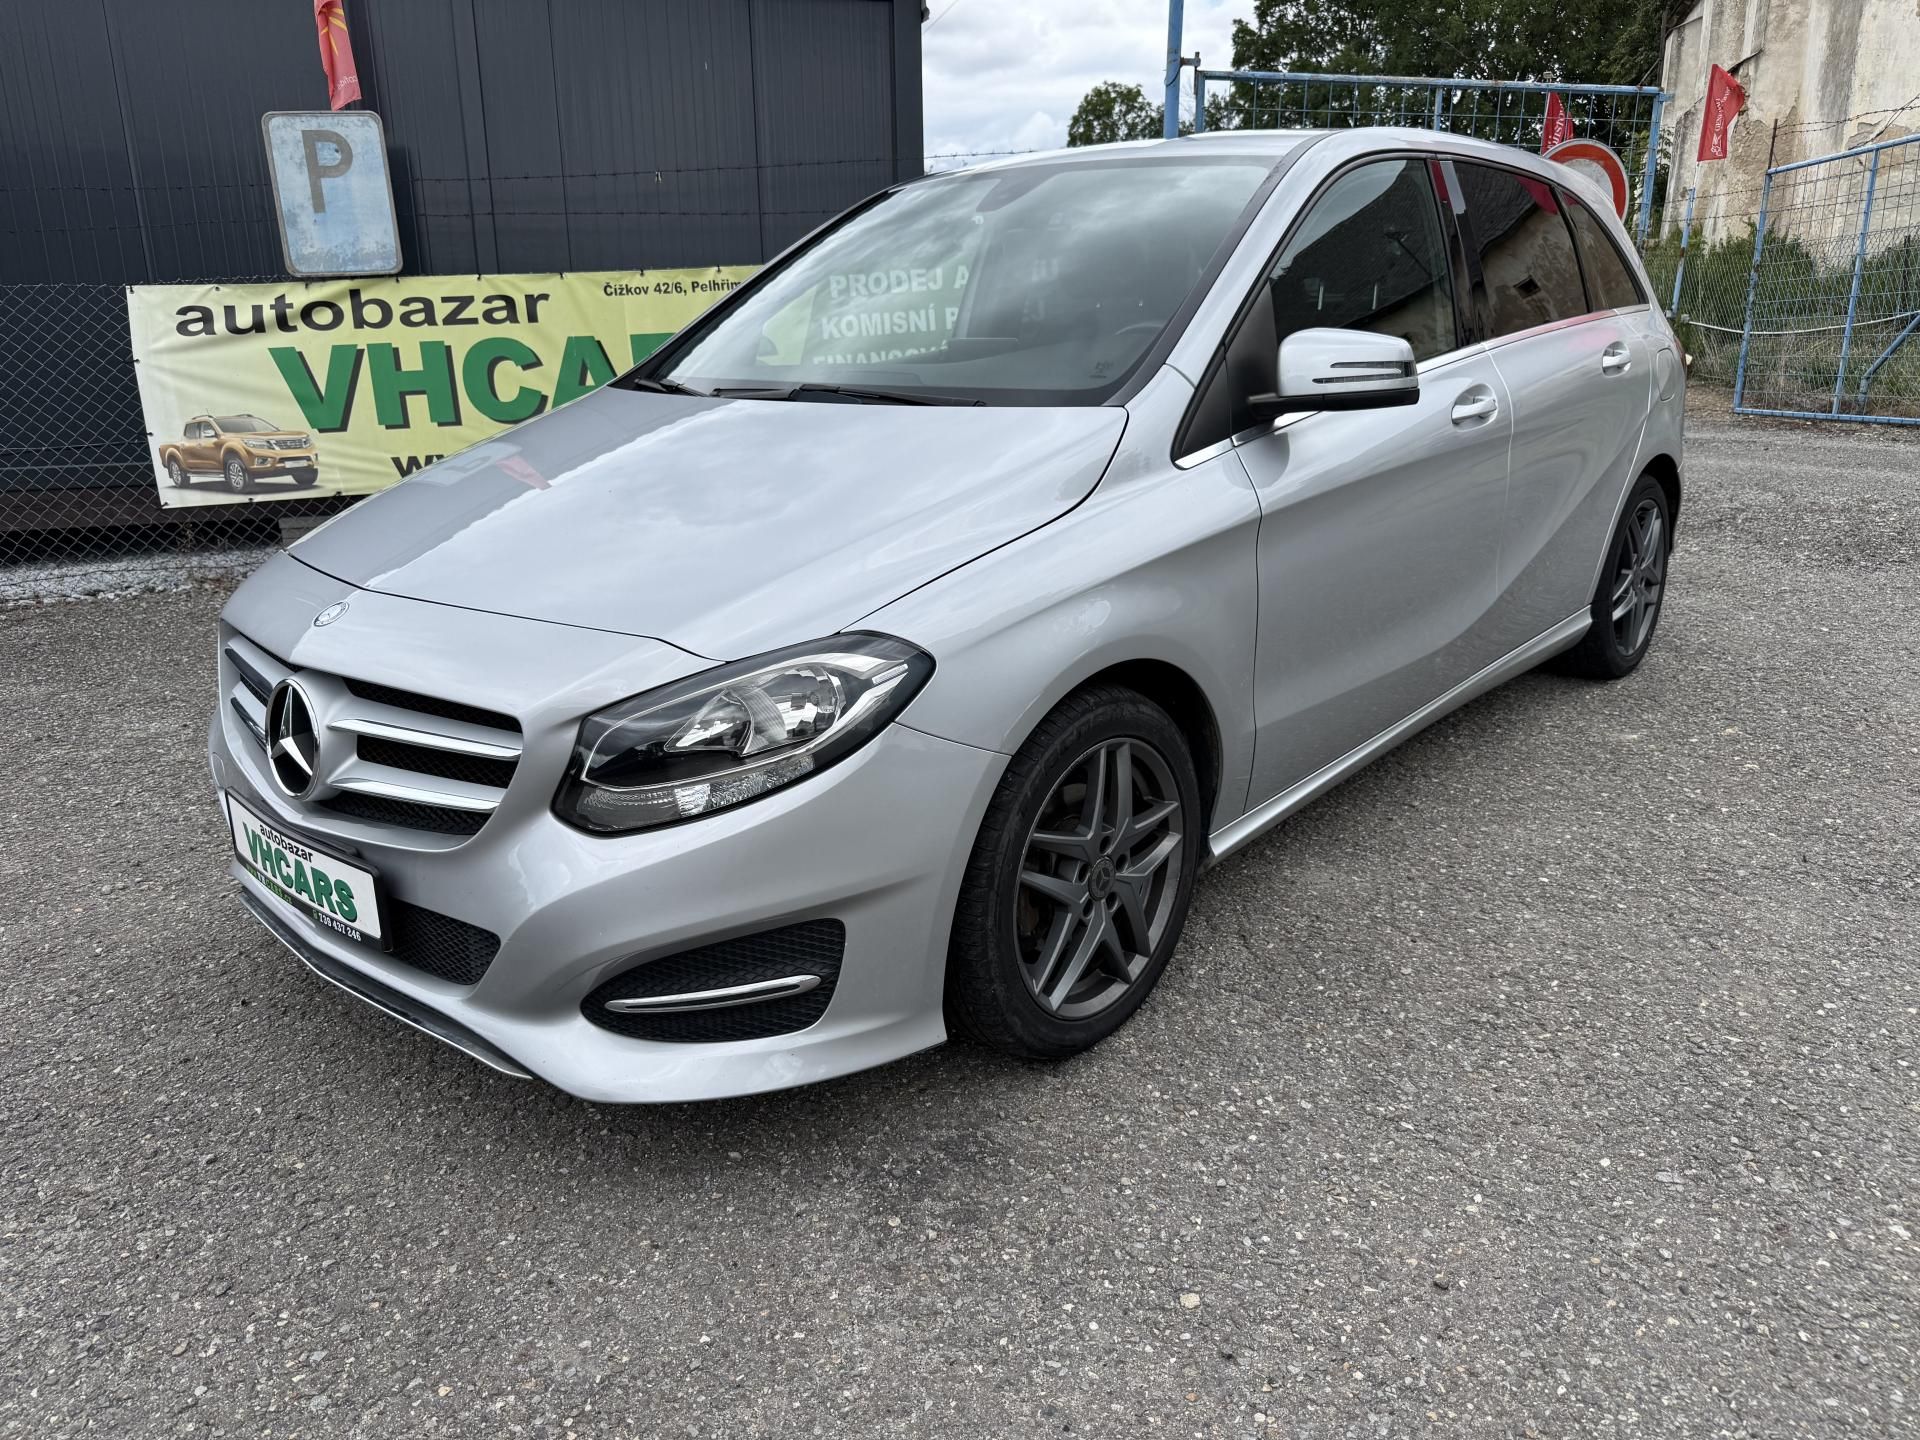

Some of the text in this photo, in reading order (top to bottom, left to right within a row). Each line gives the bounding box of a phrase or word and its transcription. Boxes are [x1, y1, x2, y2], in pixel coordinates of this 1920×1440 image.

[301, 129, 354, 214] P
[603, 282, 650, 298] Čížkov
[653, 281, 688, 297] 42/6,
[829, 266, 943, 299] PRODEJ
[175, 288, 551, 338] autobazar
[821, 303, 937, 340] KOMISNÍ
[259, 824, 314, 863] autobazar
[242, 820, 358, 924] VHCARS
